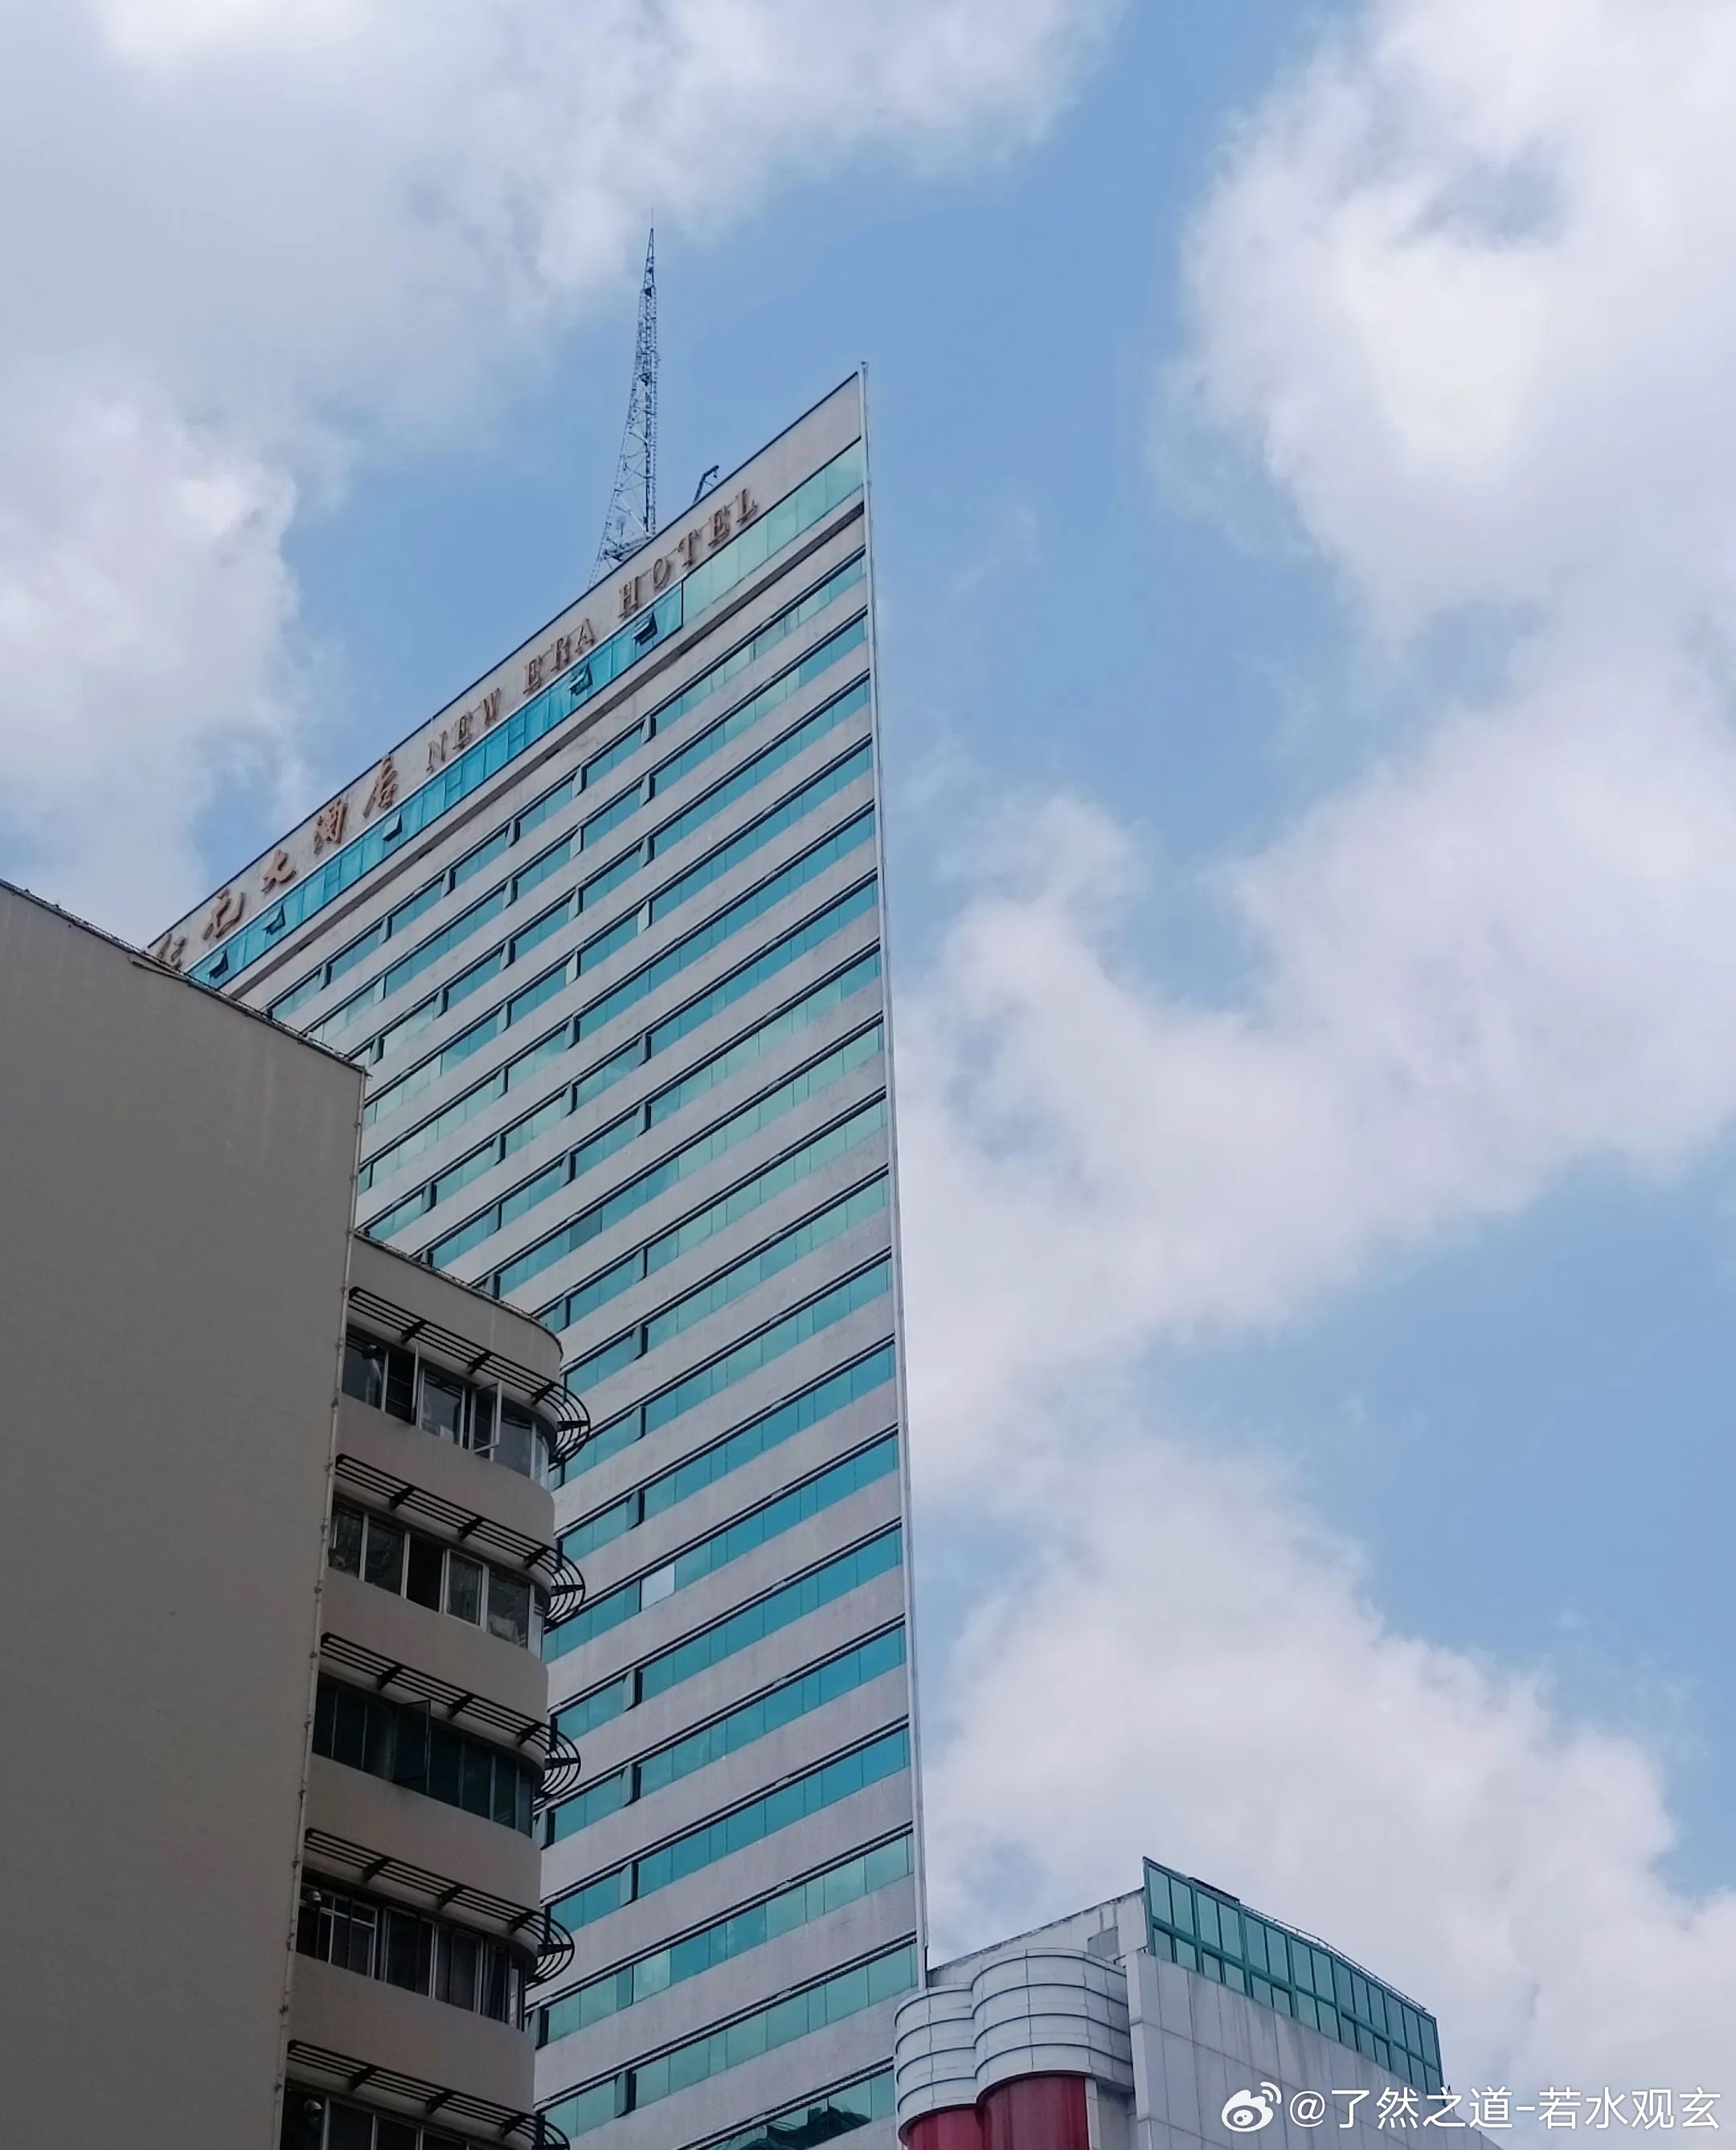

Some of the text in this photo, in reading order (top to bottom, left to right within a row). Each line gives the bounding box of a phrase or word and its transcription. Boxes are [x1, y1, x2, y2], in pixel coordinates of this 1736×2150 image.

[426, 488, 760, 773] NEW ERA HOTEL
